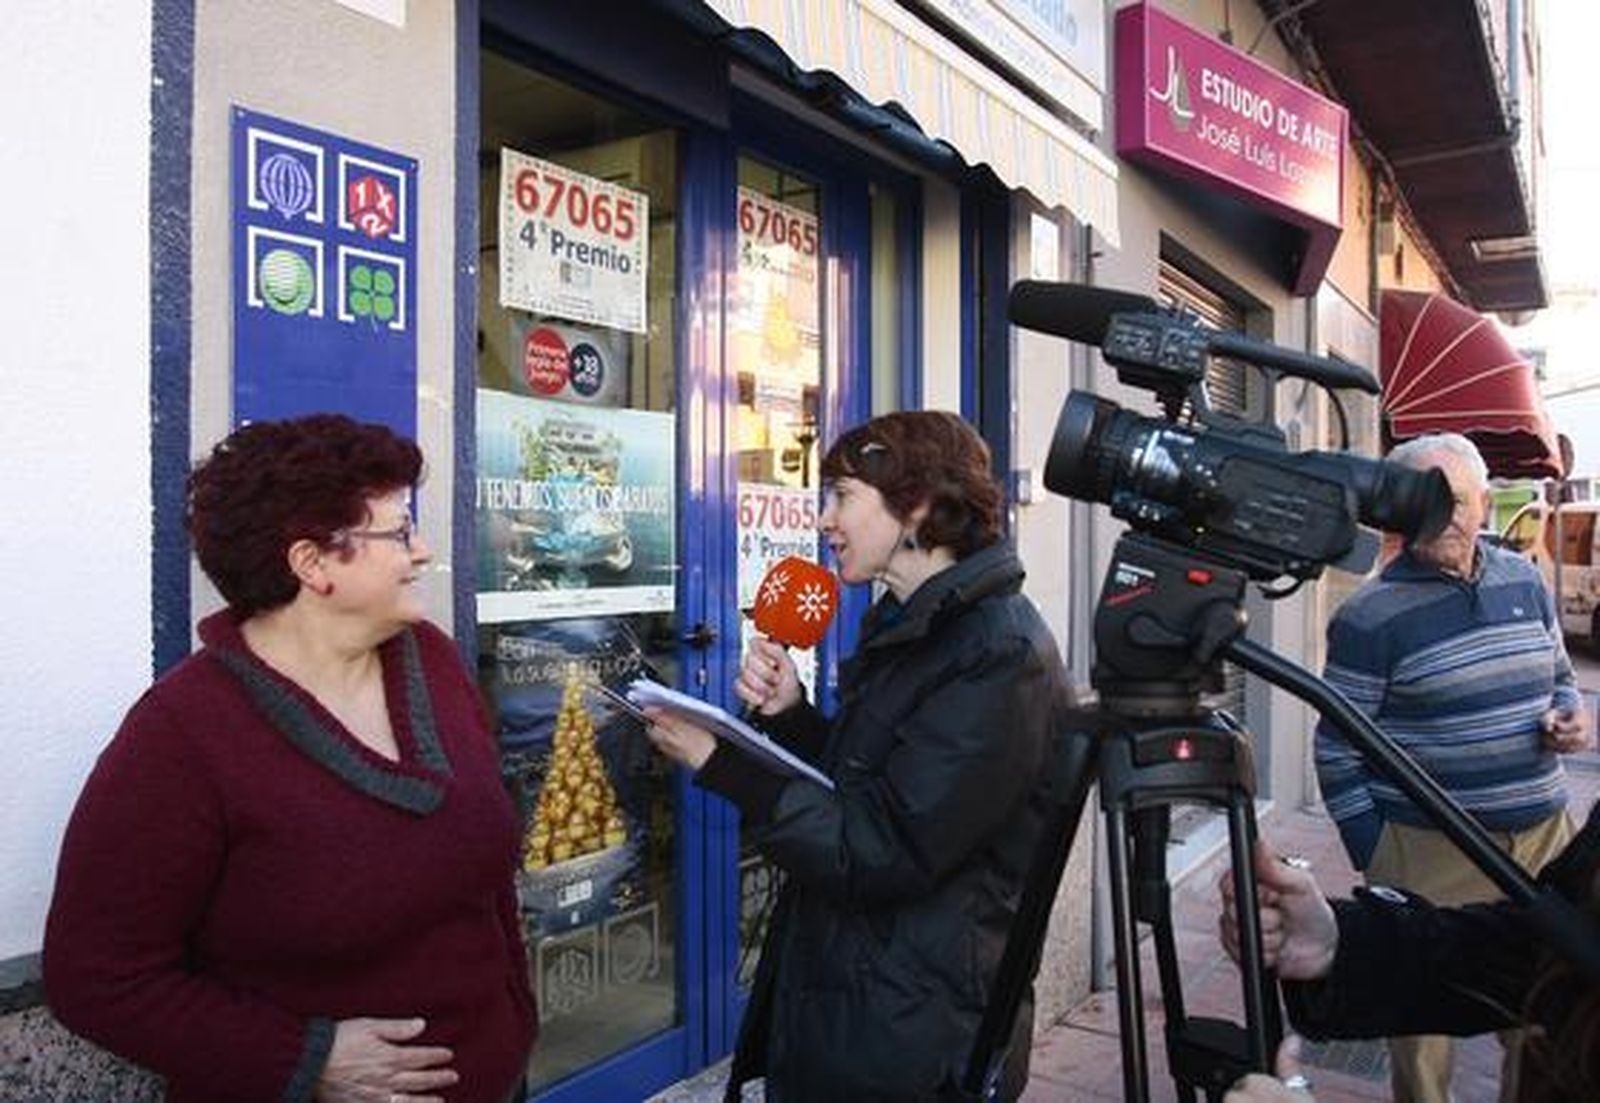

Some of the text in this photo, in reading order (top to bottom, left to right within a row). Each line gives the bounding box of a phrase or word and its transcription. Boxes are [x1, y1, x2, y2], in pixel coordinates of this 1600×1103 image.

[1196, 115, 1241, 155] José
[1201, 68, 1338, 162] ESTUDIO DE ARTE
[514, 168, 635, 242] 67065
[739, 200, 817, 256] 67065
[551, 229, 632, 275] Premio
[738, 493, 816, 531] 67065
[760, 536, 814, 558] Premio
